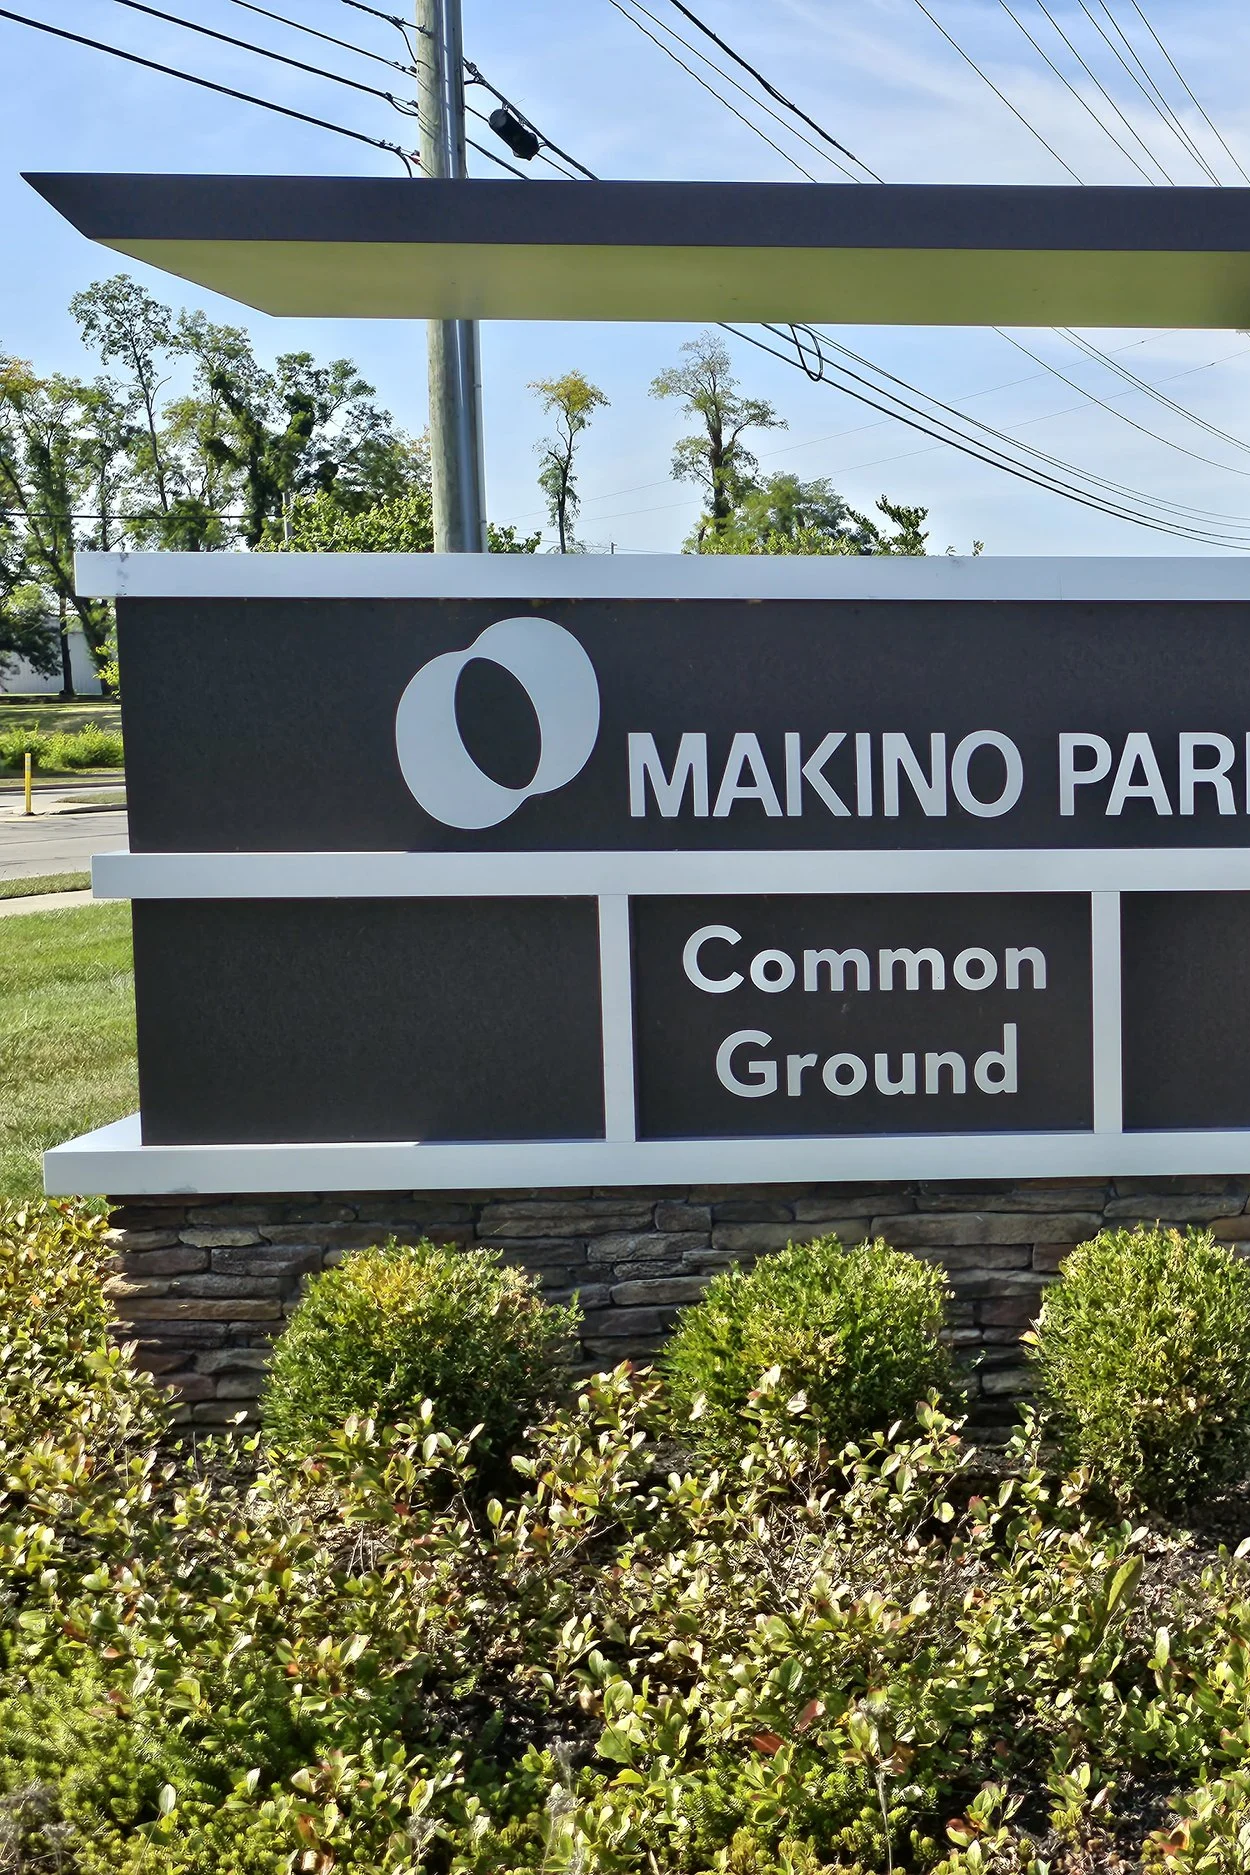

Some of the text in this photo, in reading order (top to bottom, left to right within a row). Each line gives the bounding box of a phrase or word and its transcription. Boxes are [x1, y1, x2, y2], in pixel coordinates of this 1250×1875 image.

[627, 729, 1024, 818] MAKINO
[682, 924, 1047, 994] Common
[715, 1022, 1018, 1098] Ground
